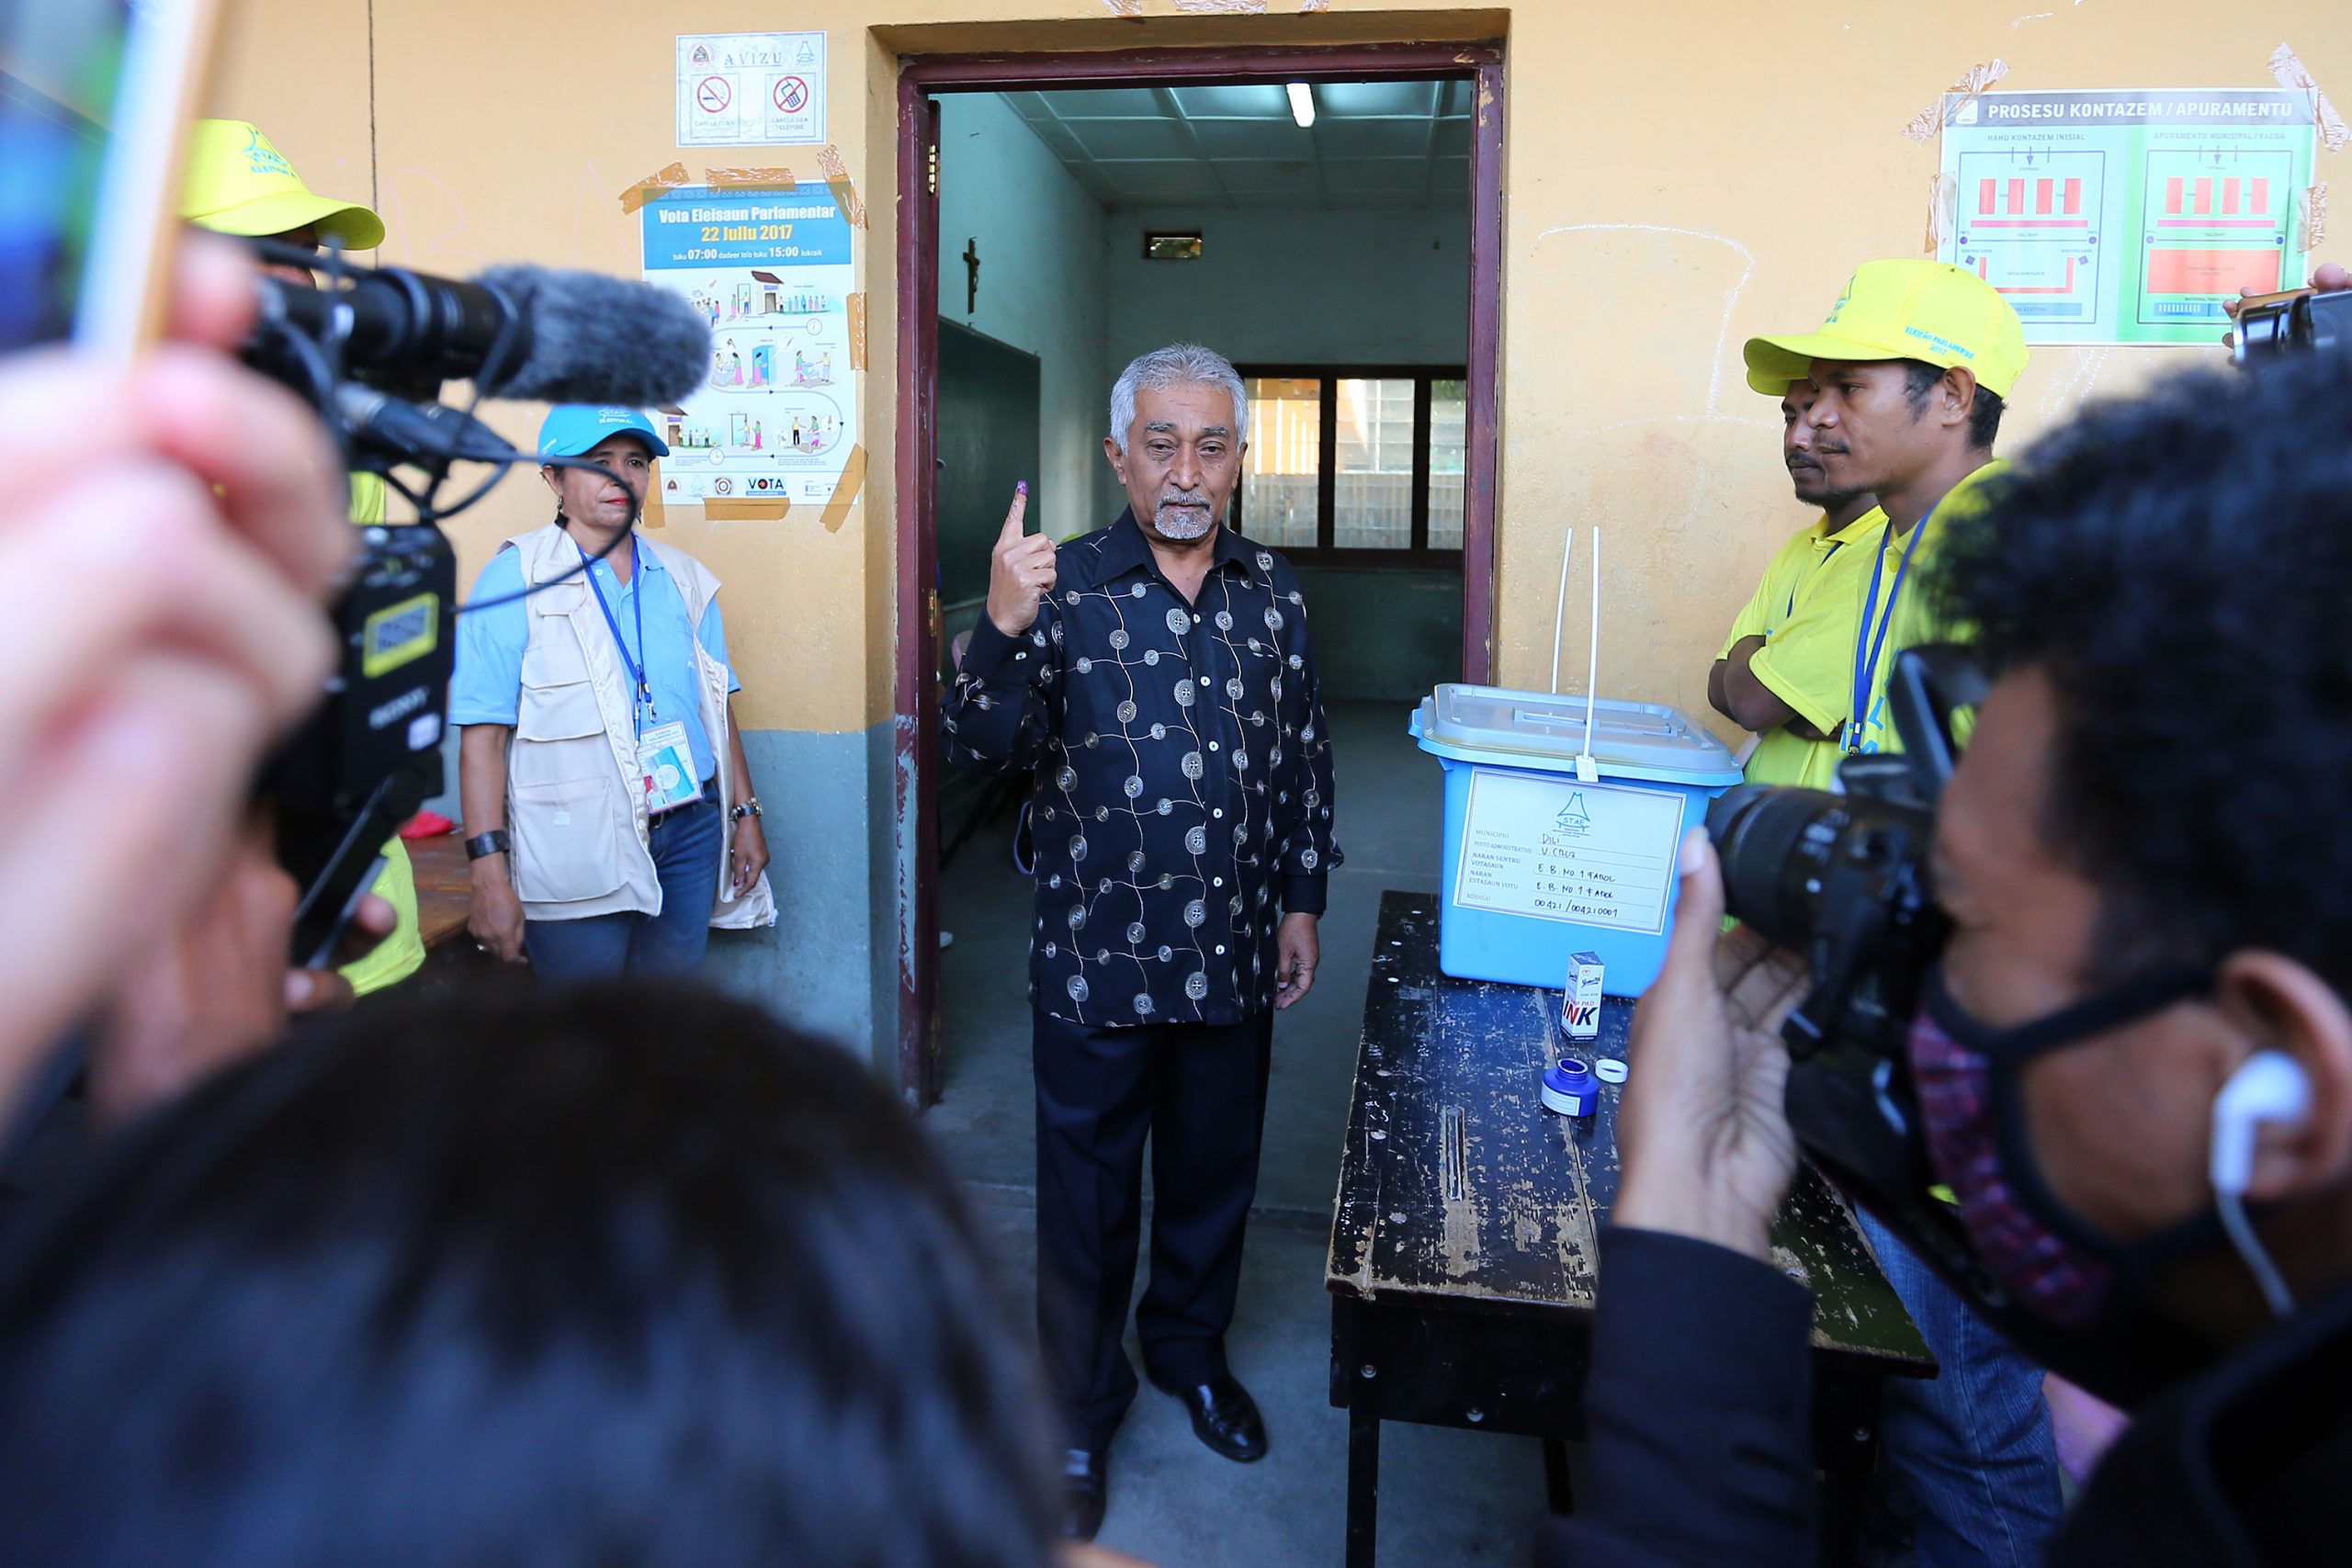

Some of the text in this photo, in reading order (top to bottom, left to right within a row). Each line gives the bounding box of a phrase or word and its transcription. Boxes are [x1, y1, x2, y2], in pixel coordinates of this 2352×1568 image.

[724, 51, 783, 66] AVIZU
[1987, 103, 2064, 118] PROSESU
[2069, 102, 2163, 118] KONTAZEM
[2177, 102, 2293, 118] APURAMENTU
[659, 205, 837, 223] Vota Eleisaun Parlamentar
[701, 226, 720, 242] 22
[760, 224, 794, 240] 2017
[687, 248, 718, 260] 07:00
[768, 246, 799, 257] 15:00
[748, 479, 784, 491] VOTA
[1472, 860, 1504, 869] VOTASAUN
[1496, 855, 1521, 863] SENTRU
[1470, 869, 1492, 877] NARAN
[1469, 877, 1500, 886] ESTASAUN
[1563, 999, 1599, 1026] INK
